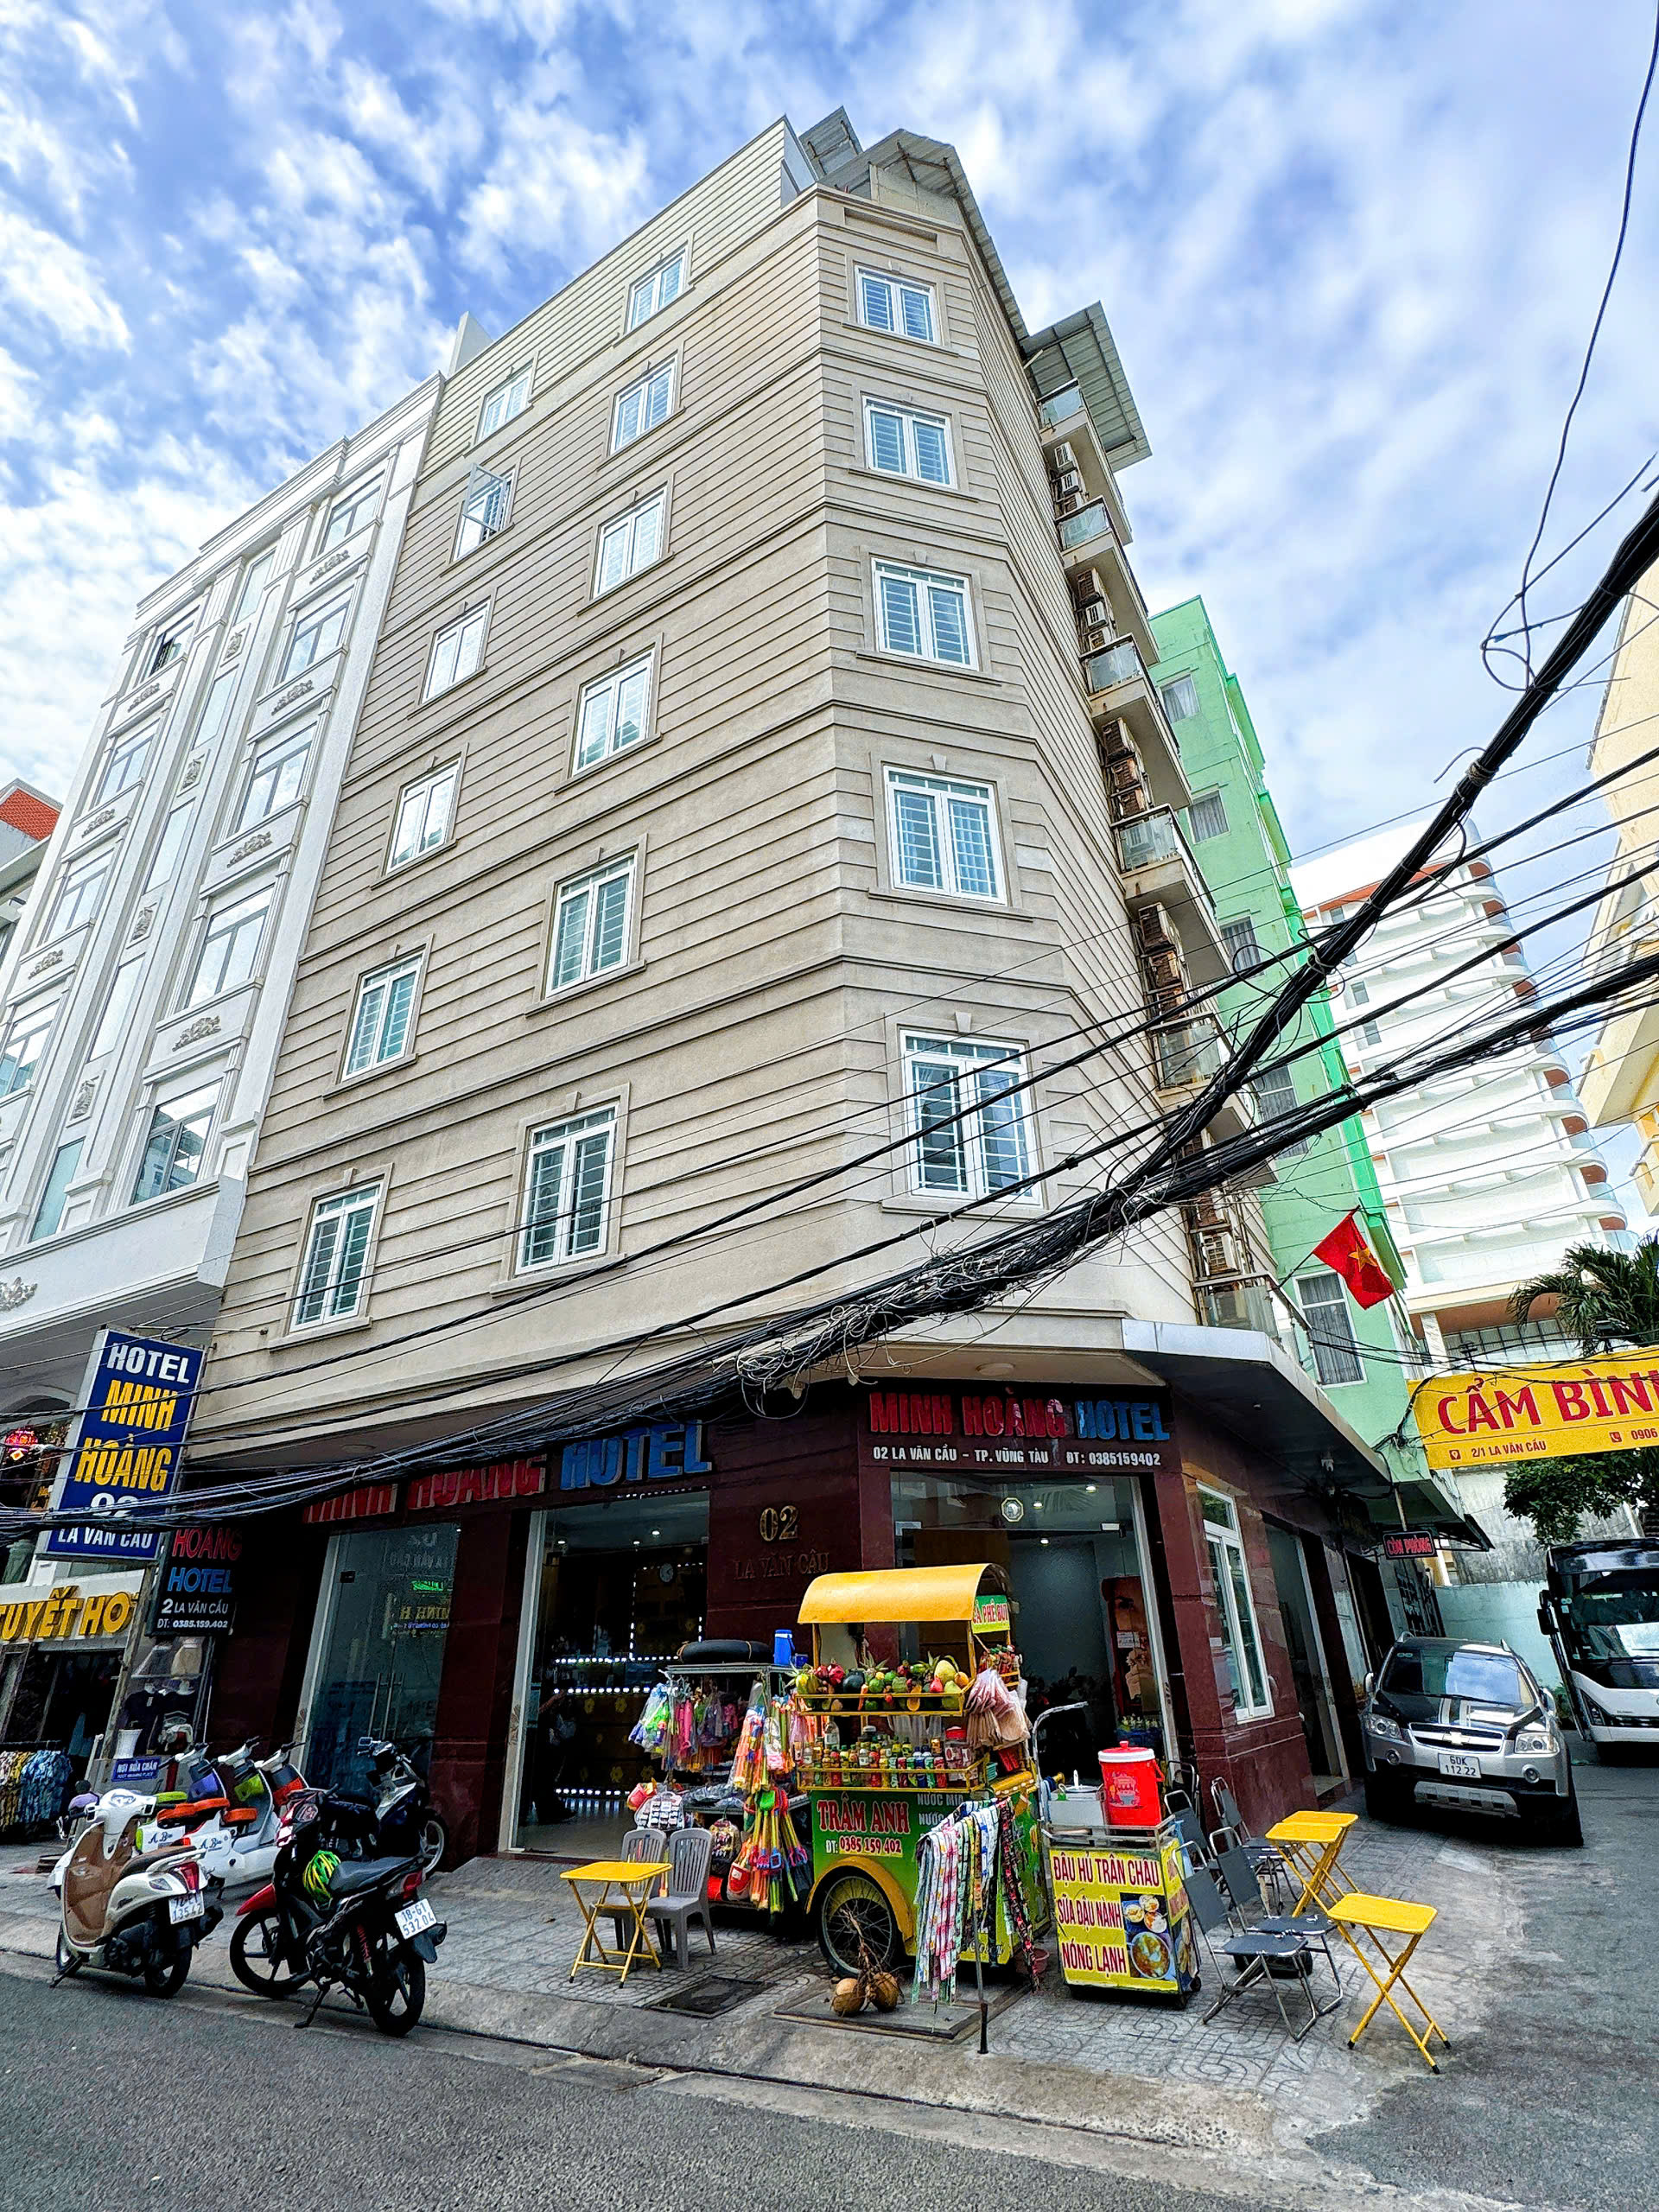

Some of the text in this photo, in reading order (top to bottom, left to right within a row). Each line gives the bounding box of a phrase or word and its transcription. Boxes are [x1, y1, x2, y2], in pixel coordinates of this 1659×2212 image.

[106, 1343, 190, 1383] HOTEL
[101, 1380, 178, 1431] MINH
[869, 1386, 1171, 1441] MINH HOÀNG HOTEL
[1437, 1377, 1541, 1434] CẨM
[1471, 1447, 1485, 1458] 2/1
[1488, 1446, 1502, 1456] LA
[1503, 1442, 1523, 1454] VĂN
[1630, 1428, 1658, 1440] 0906
[74, 1433, 172, 1491] HOÀNG
[560, 1420, 712, 1491] HOTEL
[873, 1446, 889, 1460] 02
[892, 1446, 907, 1460] LA
[909, 1445, 931, 1460] VĂN
[974, 1449, 993, 1462] TP.
[995, 1447, 1025, 1463] VŨNG
[1028, 1447, 1049, 1464] TÀU
[1089, 1452, 1161, 1466] 0385159402
[57, 1527, 79, 1544] LA
[760, 1505, 799, 1541] 02
[167, 1567, 233, 1593] HOTEL
[733, 1559, 755, 1580] LA
[161, 1598, 174, 1614] 2
[174, 1602, 185, 1613] LA
[188, 1600, 207, 1613] VĂN
[817, 1791, 911, 1834] TRÂM ANH
[840, 1835, 862, 1853] 0385
[864, 1837, 882, 1854] 159
[883, 1838, 902, 1855] 402
[1053, 1852, 1076, 1886] ĐẬU
[1077, 1852, 1094, 1883] HỦ
[1095, 1853, 1126, 1885] TRÂN
[1128, 1857, 1160, 1887] CHÂU
[1057, 1893, 1122, 1932] SỮA ĐẬU NÀNH
[1061, 1937, 1128, 1978] NÓNG LẠNH
